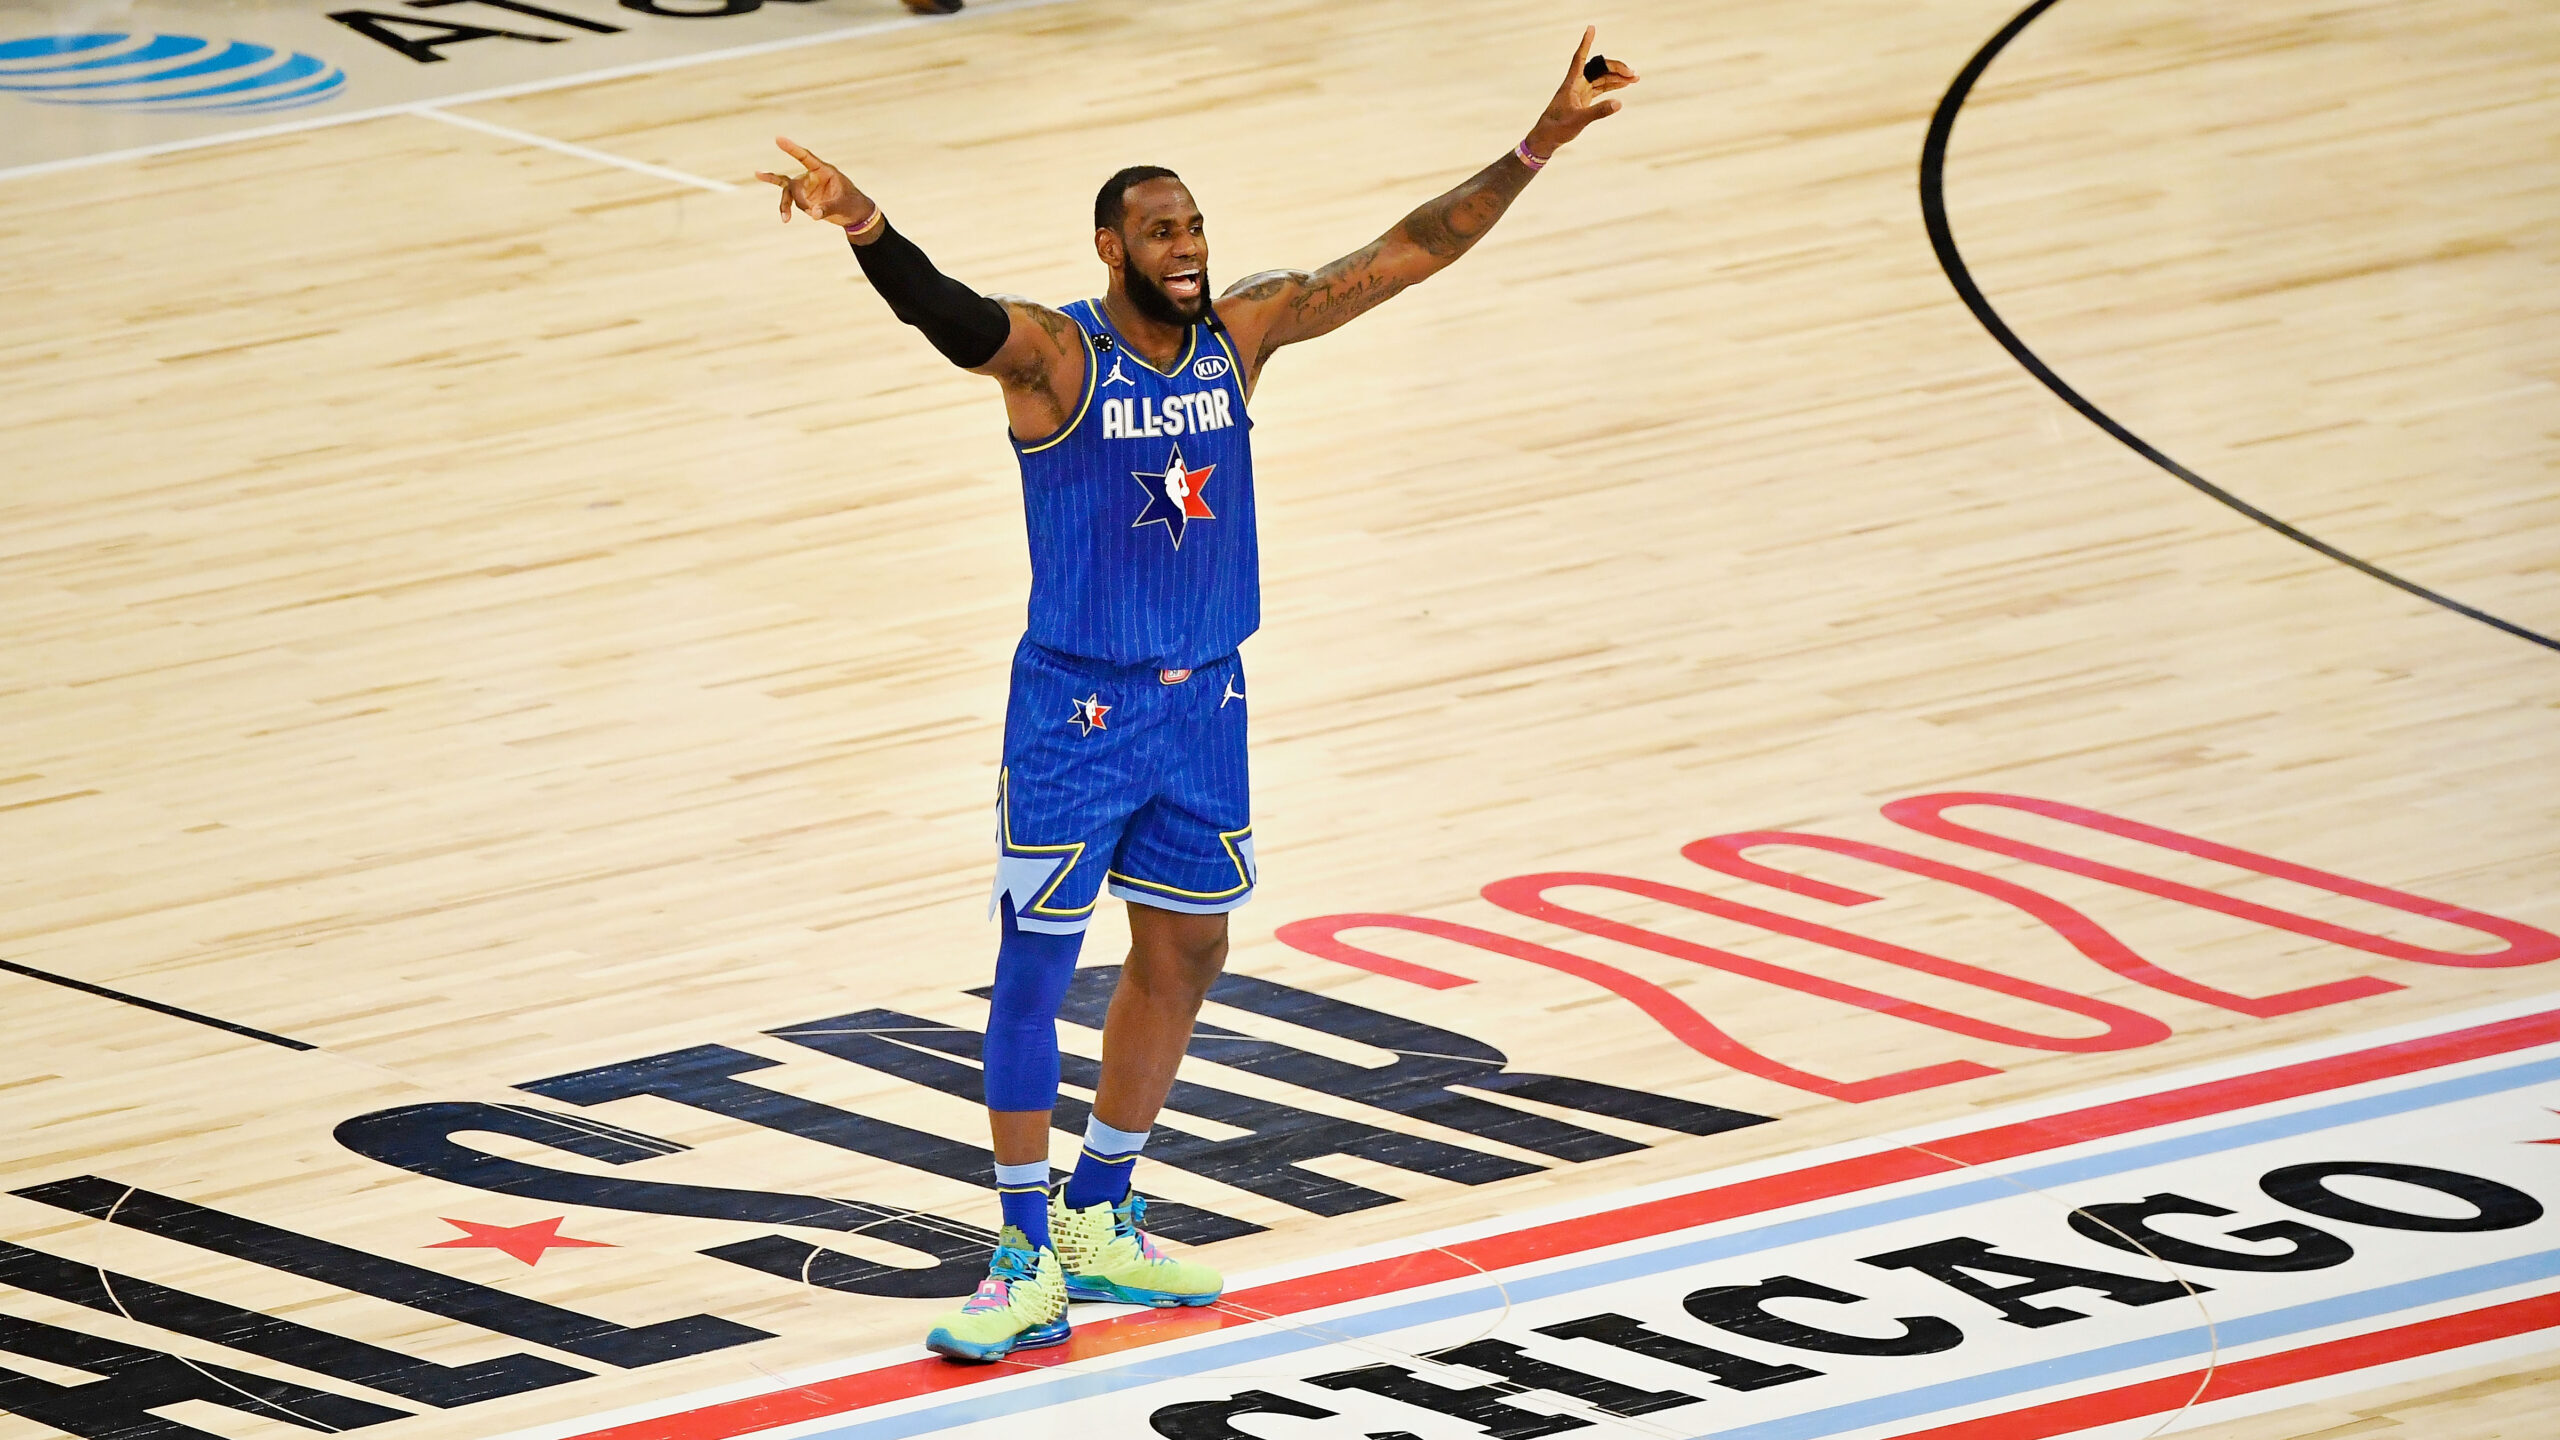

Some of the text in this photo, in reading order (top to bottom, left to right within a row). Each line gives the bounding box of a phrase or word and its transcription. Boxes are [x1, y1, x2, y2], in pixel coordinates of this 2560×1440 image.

[1197, 360, 1224, 376] KIA
[1102, 388, 1235, 440] ALL-STAR
[333, 965, 1777, 1299] STAR
[1275, 792, 2560, 1102] 2020
